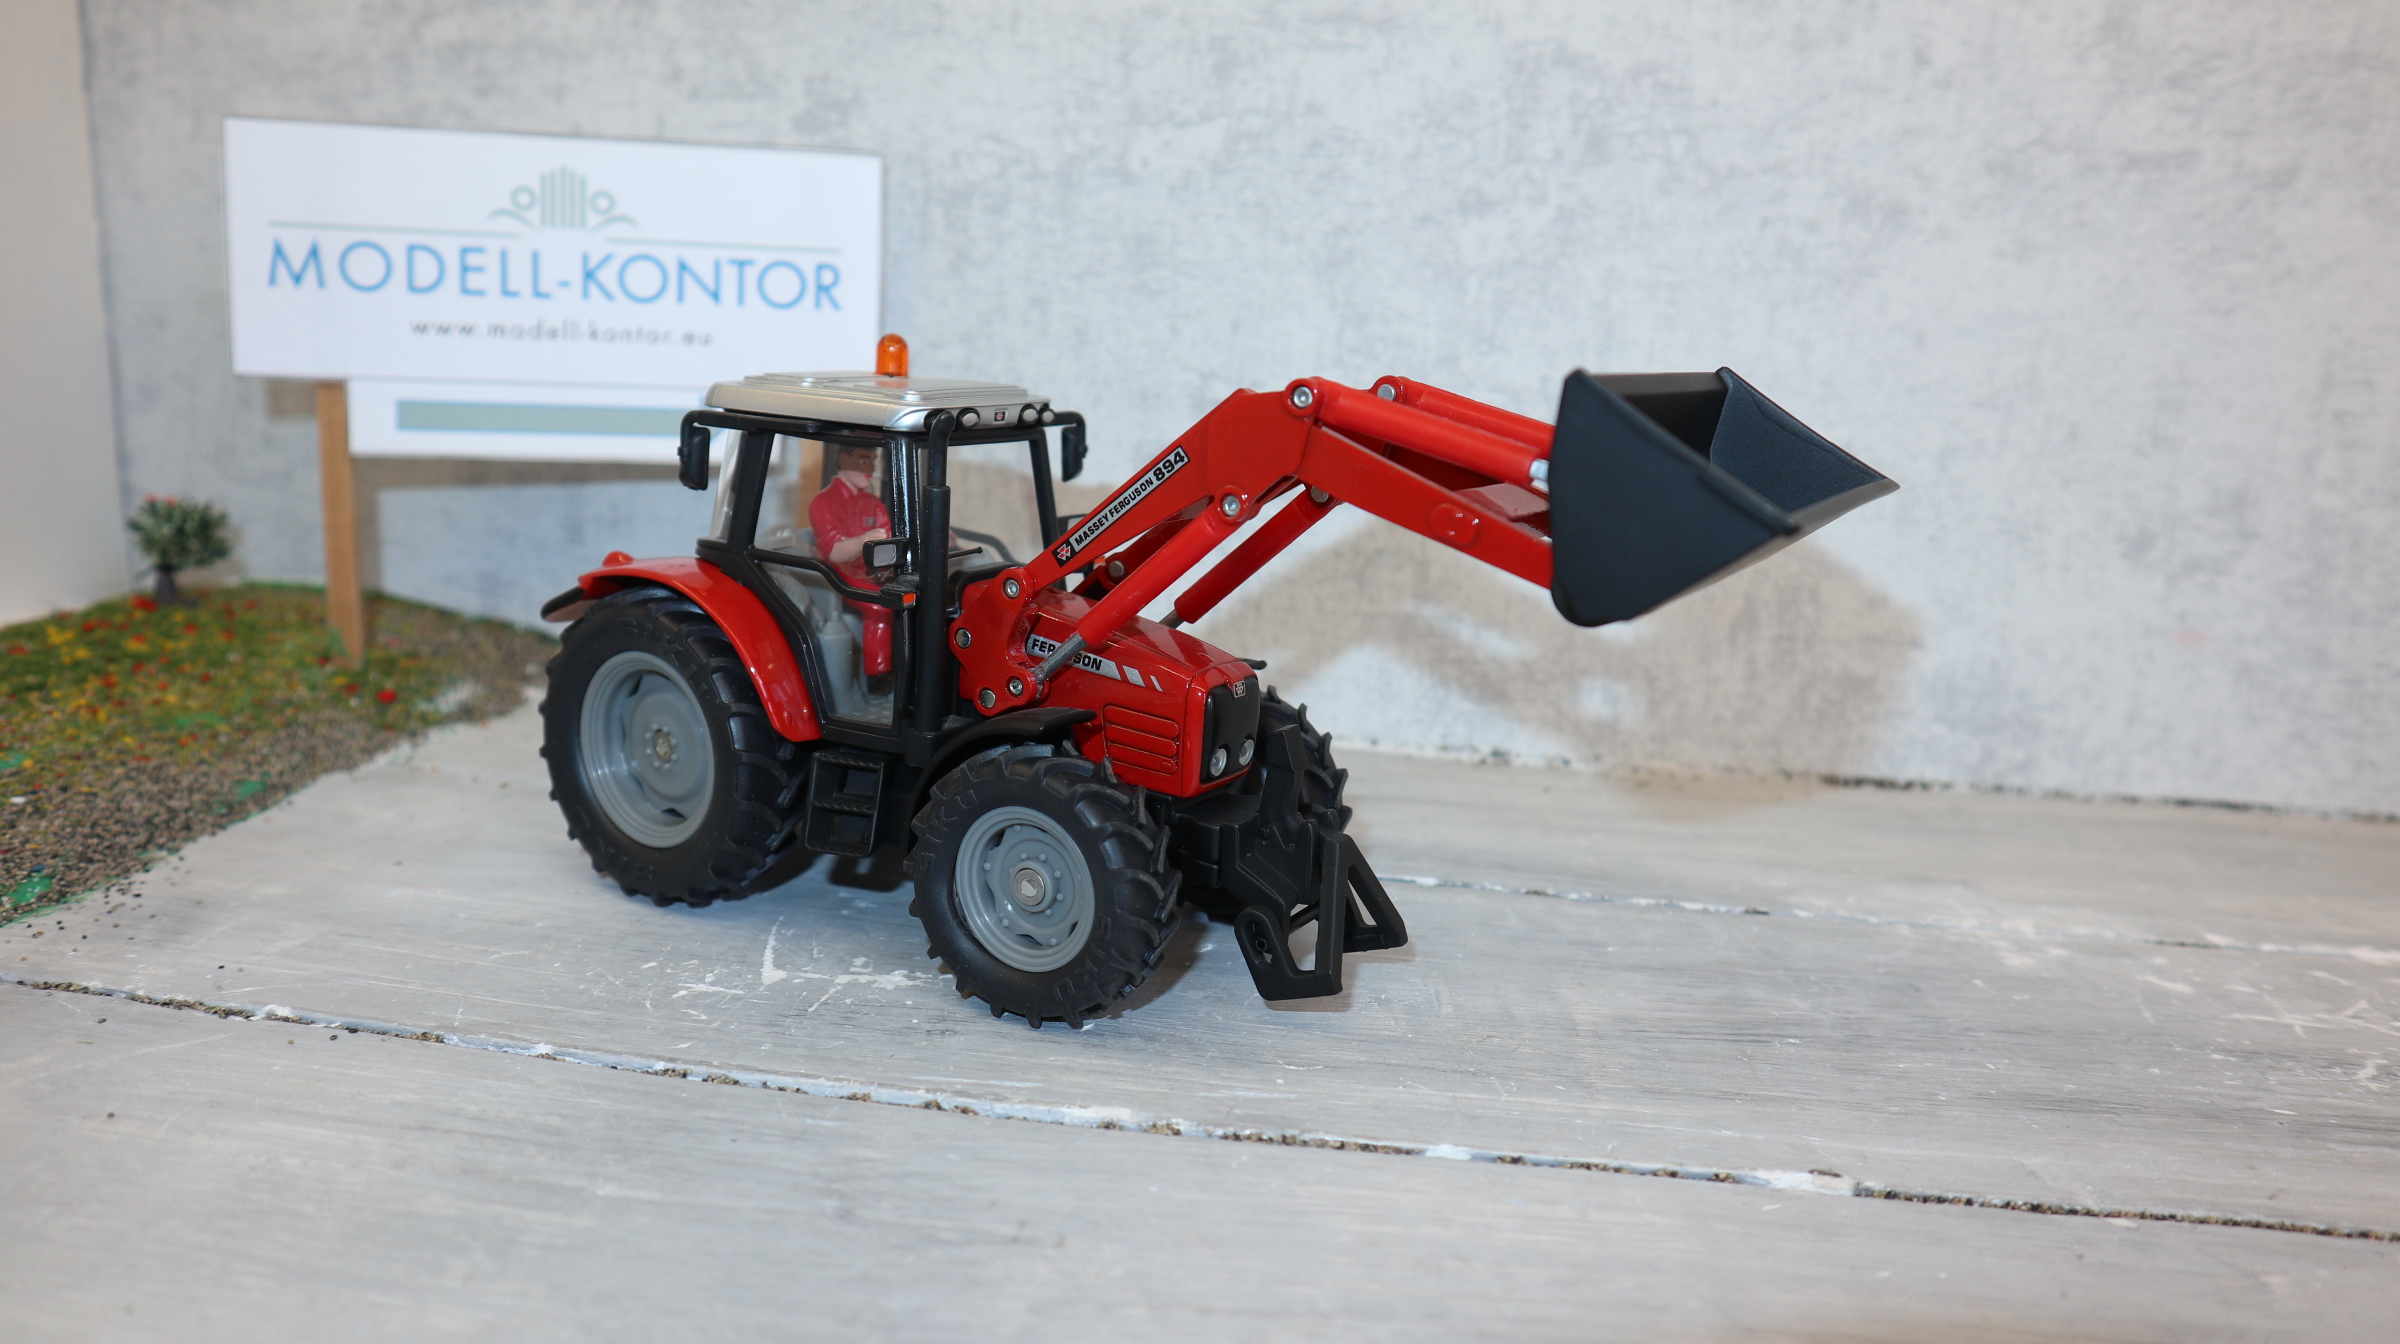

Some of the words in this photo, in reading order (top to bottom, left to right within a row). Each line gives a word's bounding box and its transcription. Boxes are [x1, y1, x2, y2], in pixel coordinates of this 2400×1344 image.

[267, 237, 843, 312] MODELL-KONTOR
[408, 316, 714, 347] www.modell-kontor.eu
[1074, 513, 1110, 547] MASSEY
[1108, 476, 1155, 518] FERGUSON
[1153, 450, 1185, 482] 894
[1031, 638, 1103, 671] FERSON
